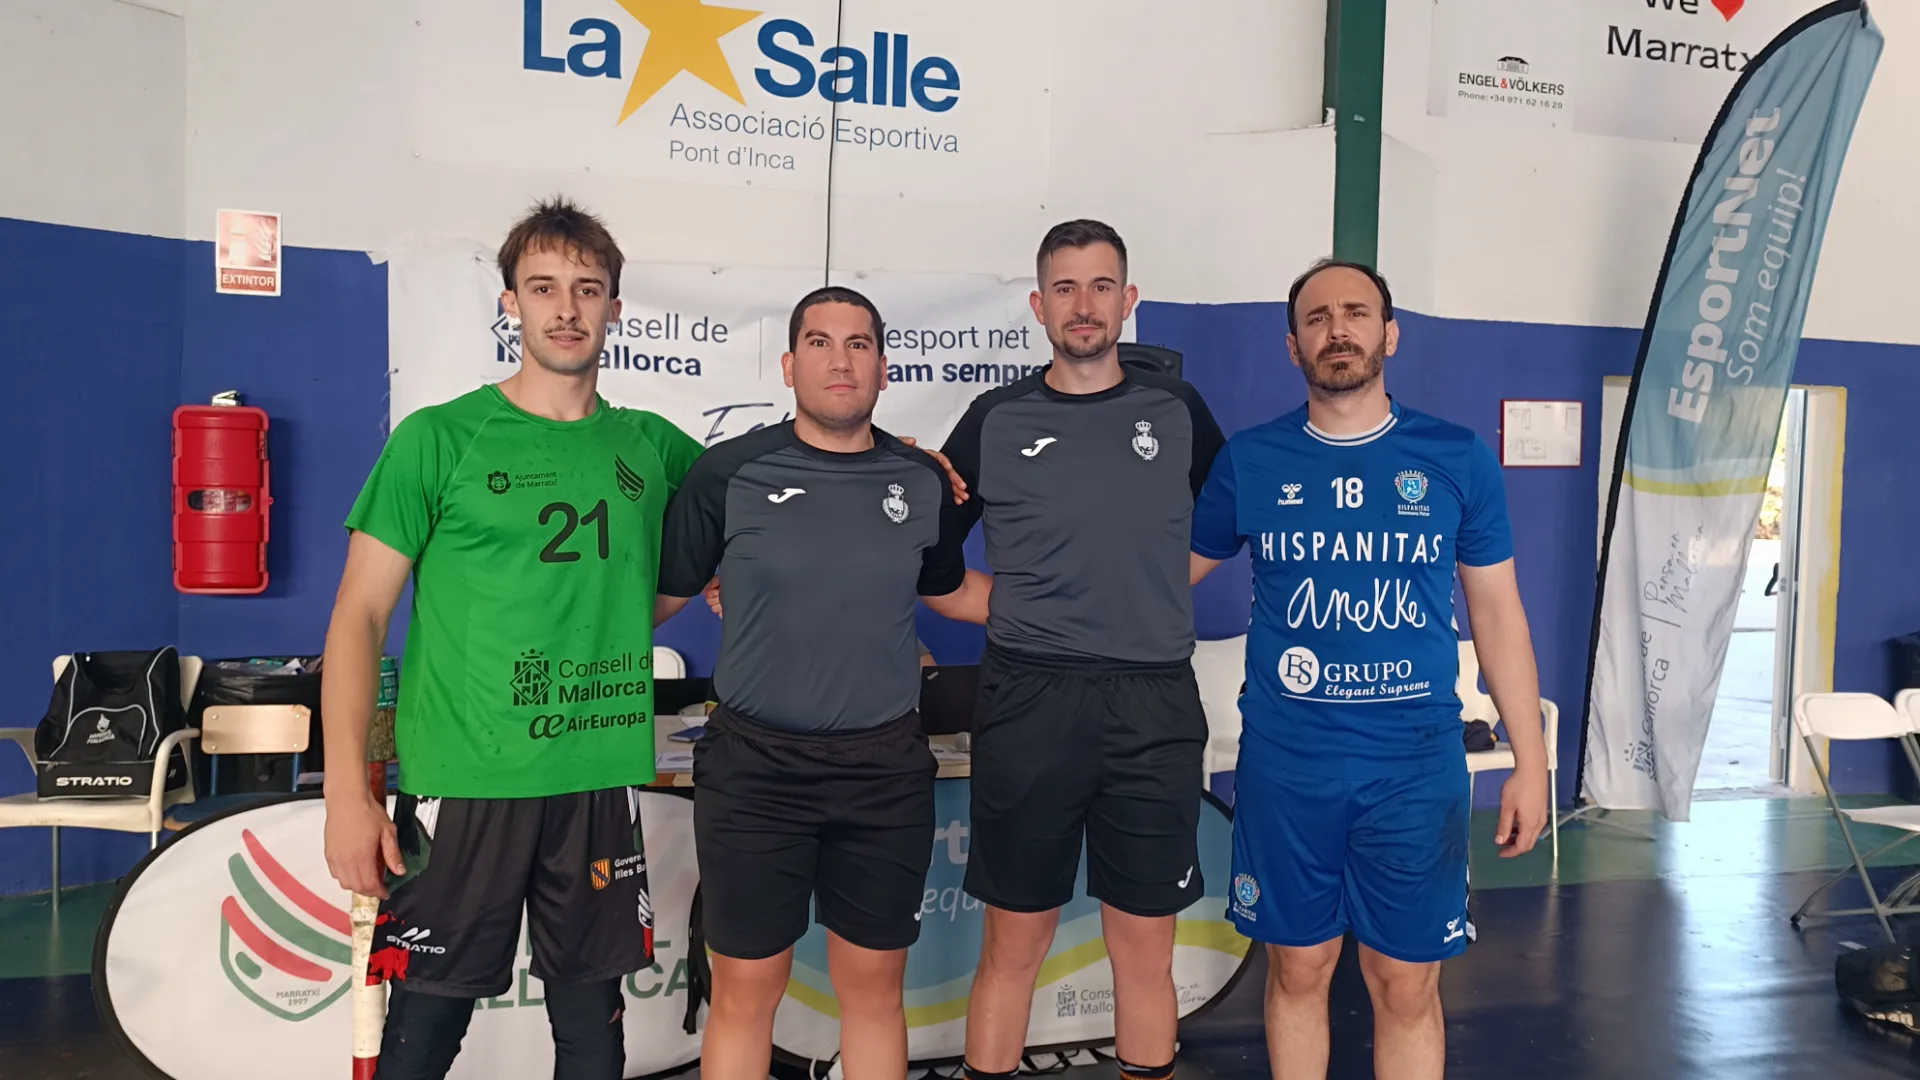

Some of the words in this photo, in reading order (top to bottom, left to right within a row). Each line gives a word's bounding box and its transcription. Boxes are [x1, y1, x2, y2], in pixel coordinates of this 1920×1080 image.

[523, 0, 622, 79] La
[753, 18, 961, 113] Salle
[1458, 90, 1489, 101] Phone:
[1507, 96, 1523, 105] 971
[1525, 99, 1537, 107] 62
[1540, 100, 1550, 108] 16
[669, 102, 825, 141] Associació
[835, 118, 959, 153] Esportiva
[669, 140, 720, 165] Pont
[727, 146, 795, 170] d'Inca
[1667, 107, 1781, 424] EsportNet
[1726, 301, 1771, 386] Som
[1758, 167, 1807, 292] equip!
[222, 273, 275, 287] EXTINTOR
[691, 316, 728, 343] de
[989, 326, 1030, 350] net
[1330, 477, 1364, 508] 18
[538, 498, 610, 563] 21
[1261, 531, 1443, 563] HISPANITAS
[558, 652, 632, 679] Consell
[638, 650, 653, 671] d
[1323, 659, 1413, 683] GRUPO
[558, 680, 647, 705] Mallorca
[1324, 684, 1377, 700] Elegant
[1379, 680, 1431, 697] Supreme
[566, 711, 647, 733] AirEuropa
[56, 776, 133, 787] STRATIO
[614, 854, 642, 868] Govern
[386, 935, 446, 955] STRATIO
